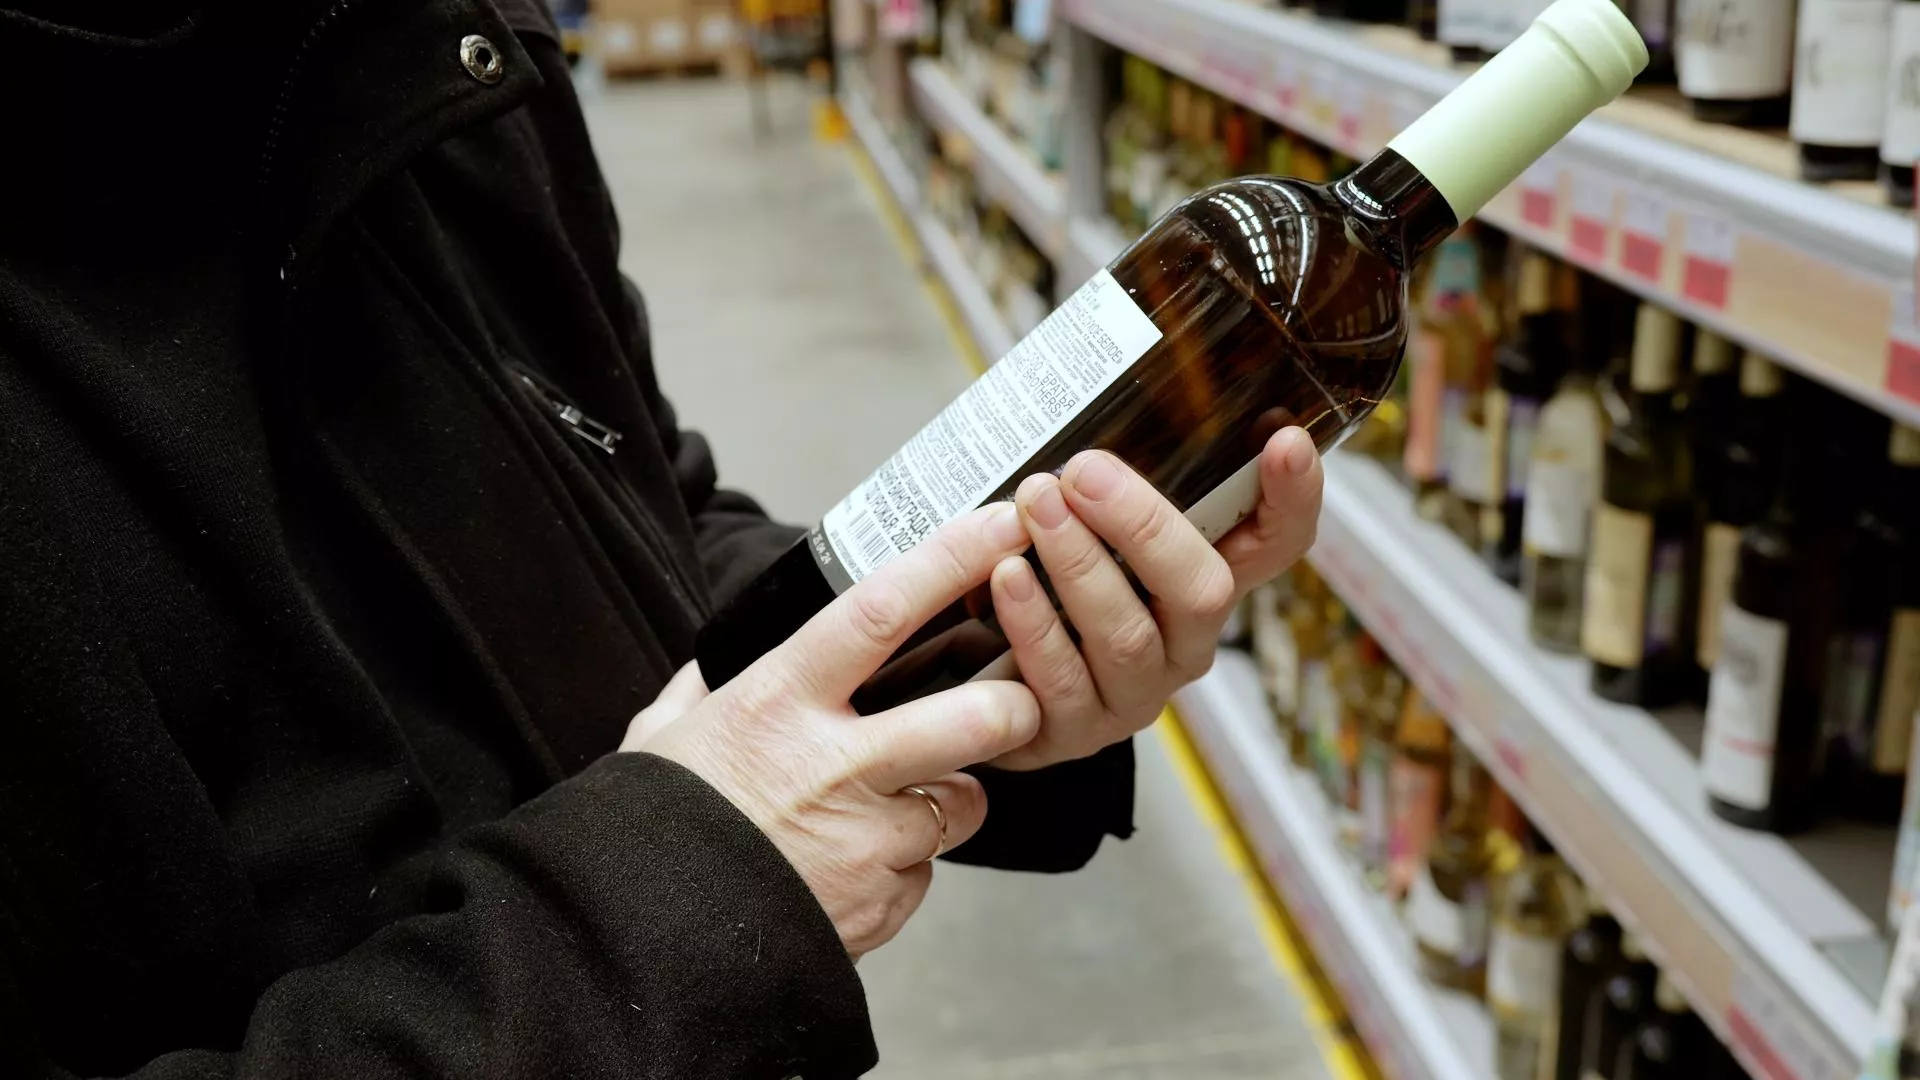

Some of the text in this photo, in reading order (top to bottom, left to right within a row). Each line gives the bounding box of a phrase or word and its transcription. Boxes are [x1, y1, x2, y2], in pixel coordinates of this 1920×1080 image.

[1096, 332, 1123, 364] БЕЛОЕ»
[1022, 367, 1062, 418] BROTHERS»
[887, 480, 931, 542] ВИНОГРАДА:
